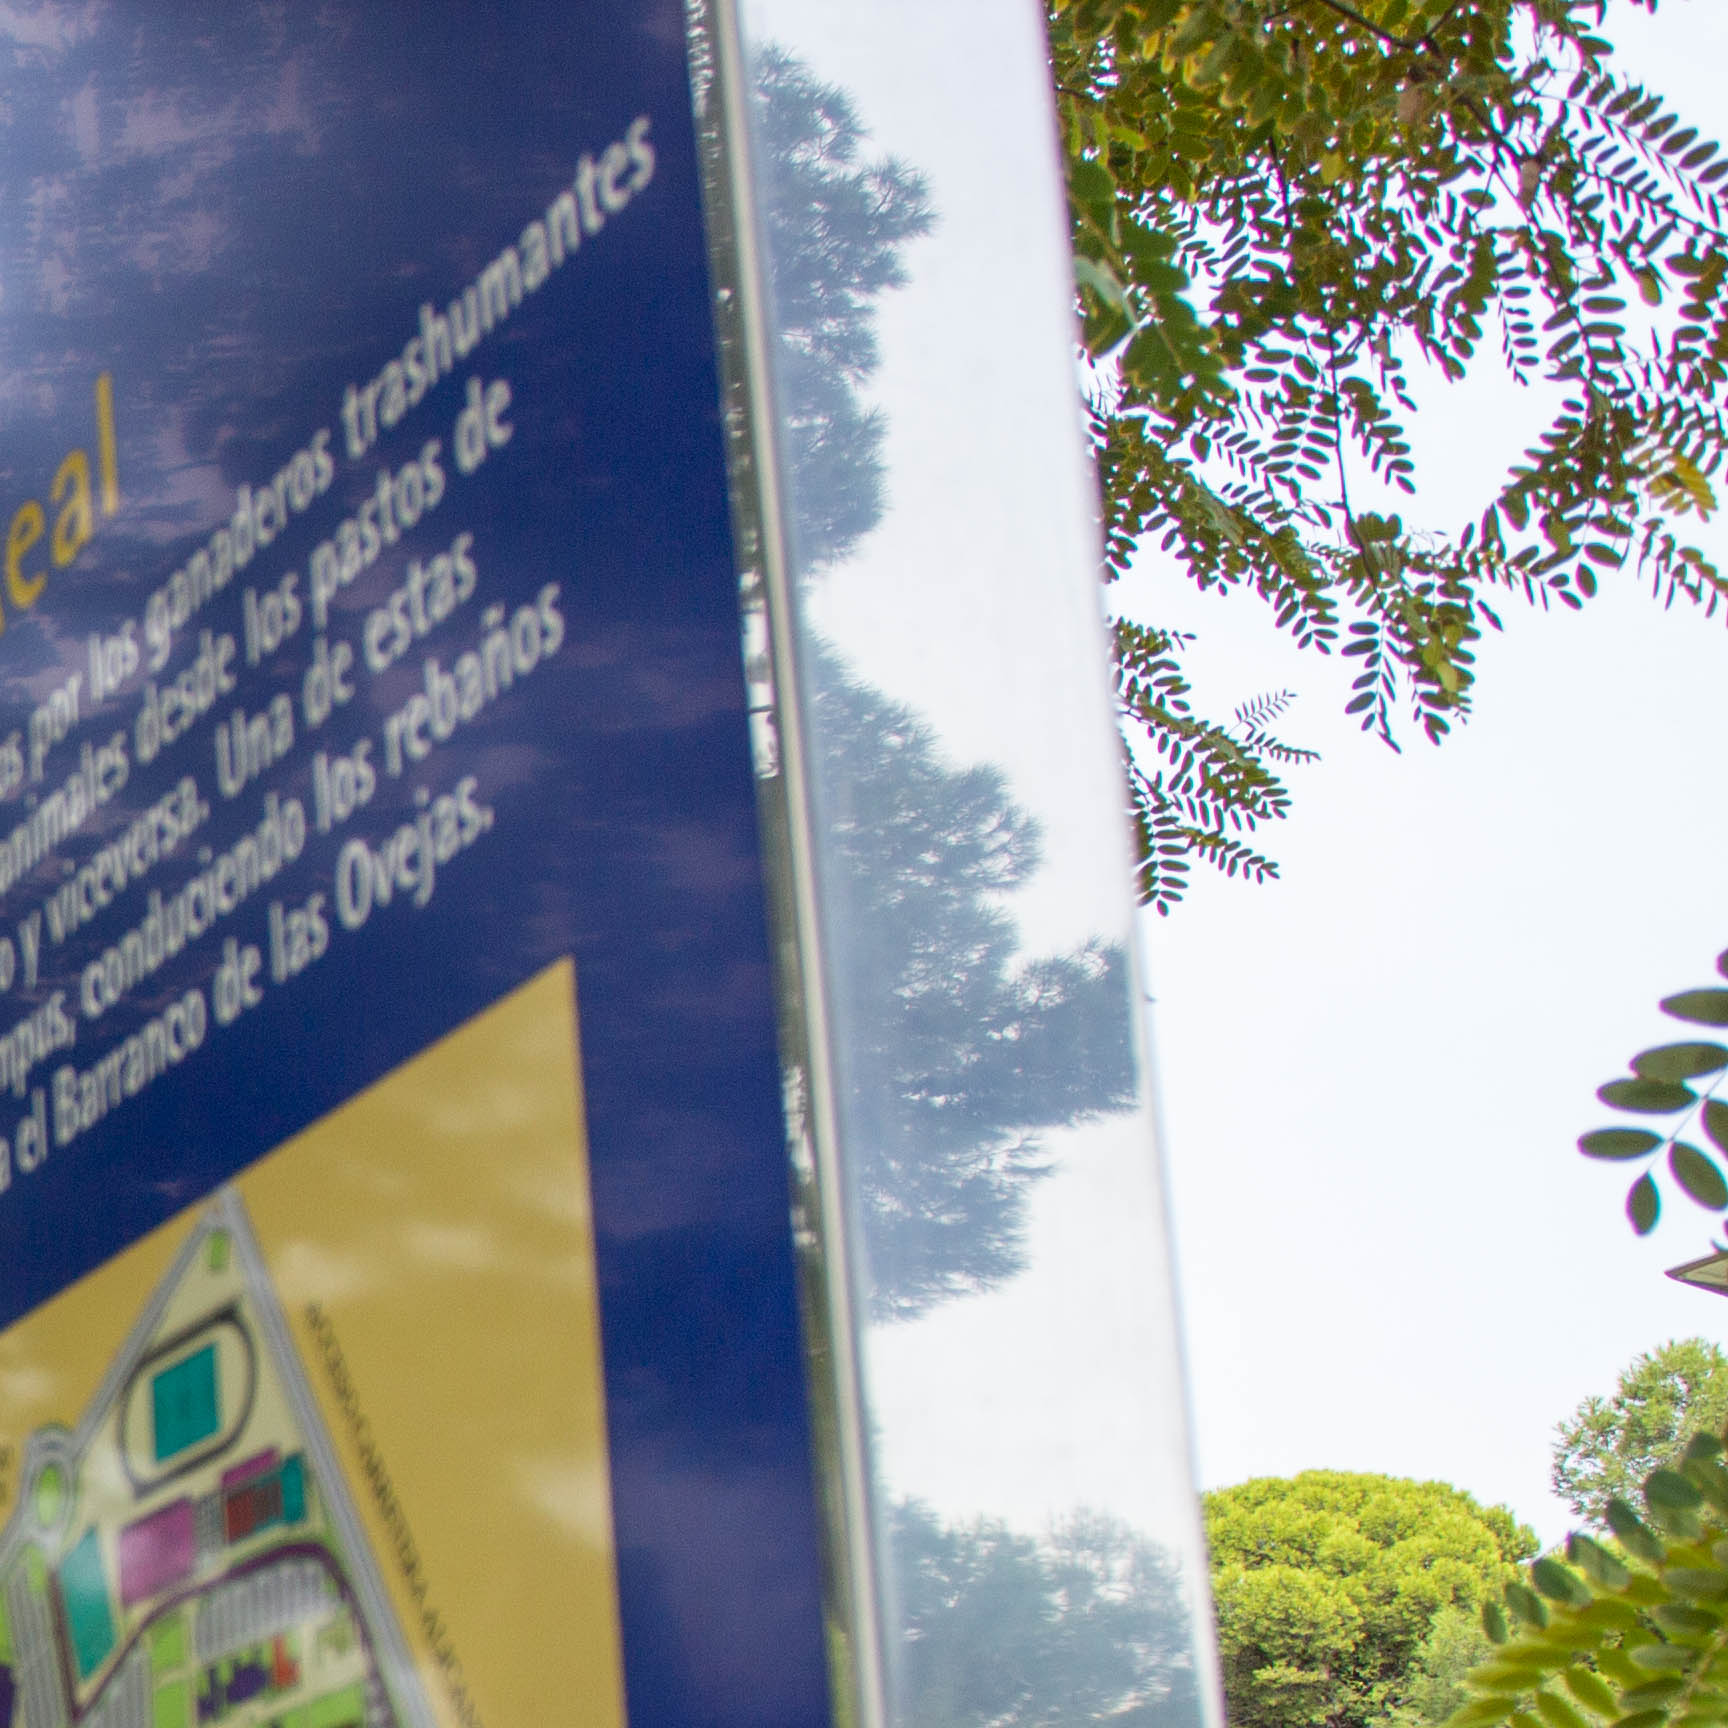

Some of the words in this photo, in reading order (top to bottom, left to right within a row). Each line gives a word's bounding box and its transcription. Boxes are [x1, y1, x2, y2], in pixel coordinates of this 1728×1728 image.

[29, 671, 82, 782] por
[88, 618, 140, 705] los
[145, 428, 335, 674] ganaderos
[341, 114, 656, 460] trashumantes
[134, 628, 237, 766] desde
[244, 571, 302, 667] los
[310, 438, 446, 631] pastos
[454, 375, 514, 475] de
[15, 1088, 48, 1174] el
[52, 988, 207, 1147] Barranco
[213, 936, 263, 1026] de
[269, 893, 330, 984] las
[335, 775, 495, 931] Ovejas.
[18, 909, 42, 991] y
[46, 775, 211, 944] viceversa.
[215, 693, 294, 799] Una
[303, 636, 356, 727] de
[364, 532, 478, 672] estas
[80, 790, 306, 1019] conduciendo
[313, 738, 377, 834] los
[384, 582, 565, 777] rebaños
